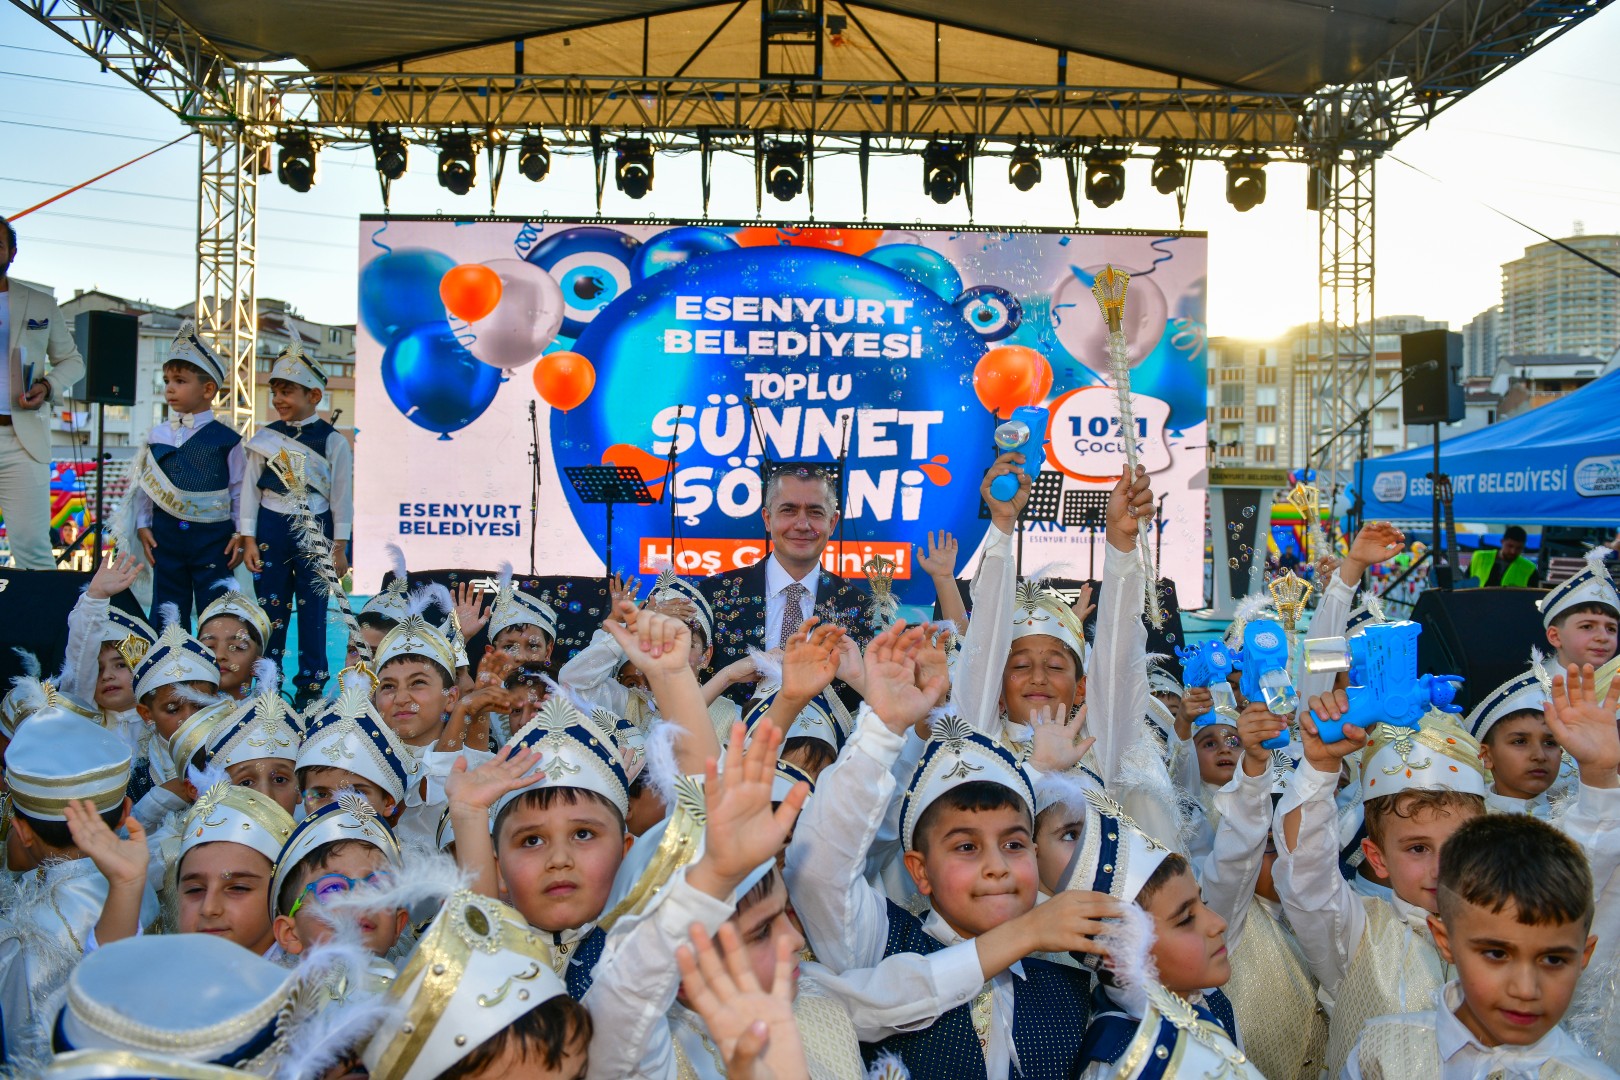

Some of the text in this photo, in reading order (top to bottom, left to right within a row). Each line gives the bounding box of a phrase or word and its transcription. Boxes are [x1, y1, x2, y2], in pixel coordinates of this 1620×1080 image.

[675, 295, 913, 325] ESENYURT
[663, 324, 922, 359] BELEDİYESİ
[745, 373, 852, 401] TOPLU
[651, 393, 944, 460] SÜNNET
[668, 456, 924, 526] ŞÖNİ
[1478, 464, 1568, 493] BELEDİYESİ
[399, 503, 522, 519] ESENYURT
[398, 519, 521, 537] BELEDİYESİ
[1029, 535, 1068, 544] ESENYURT
[646, 543, 724, 577] Hoş
